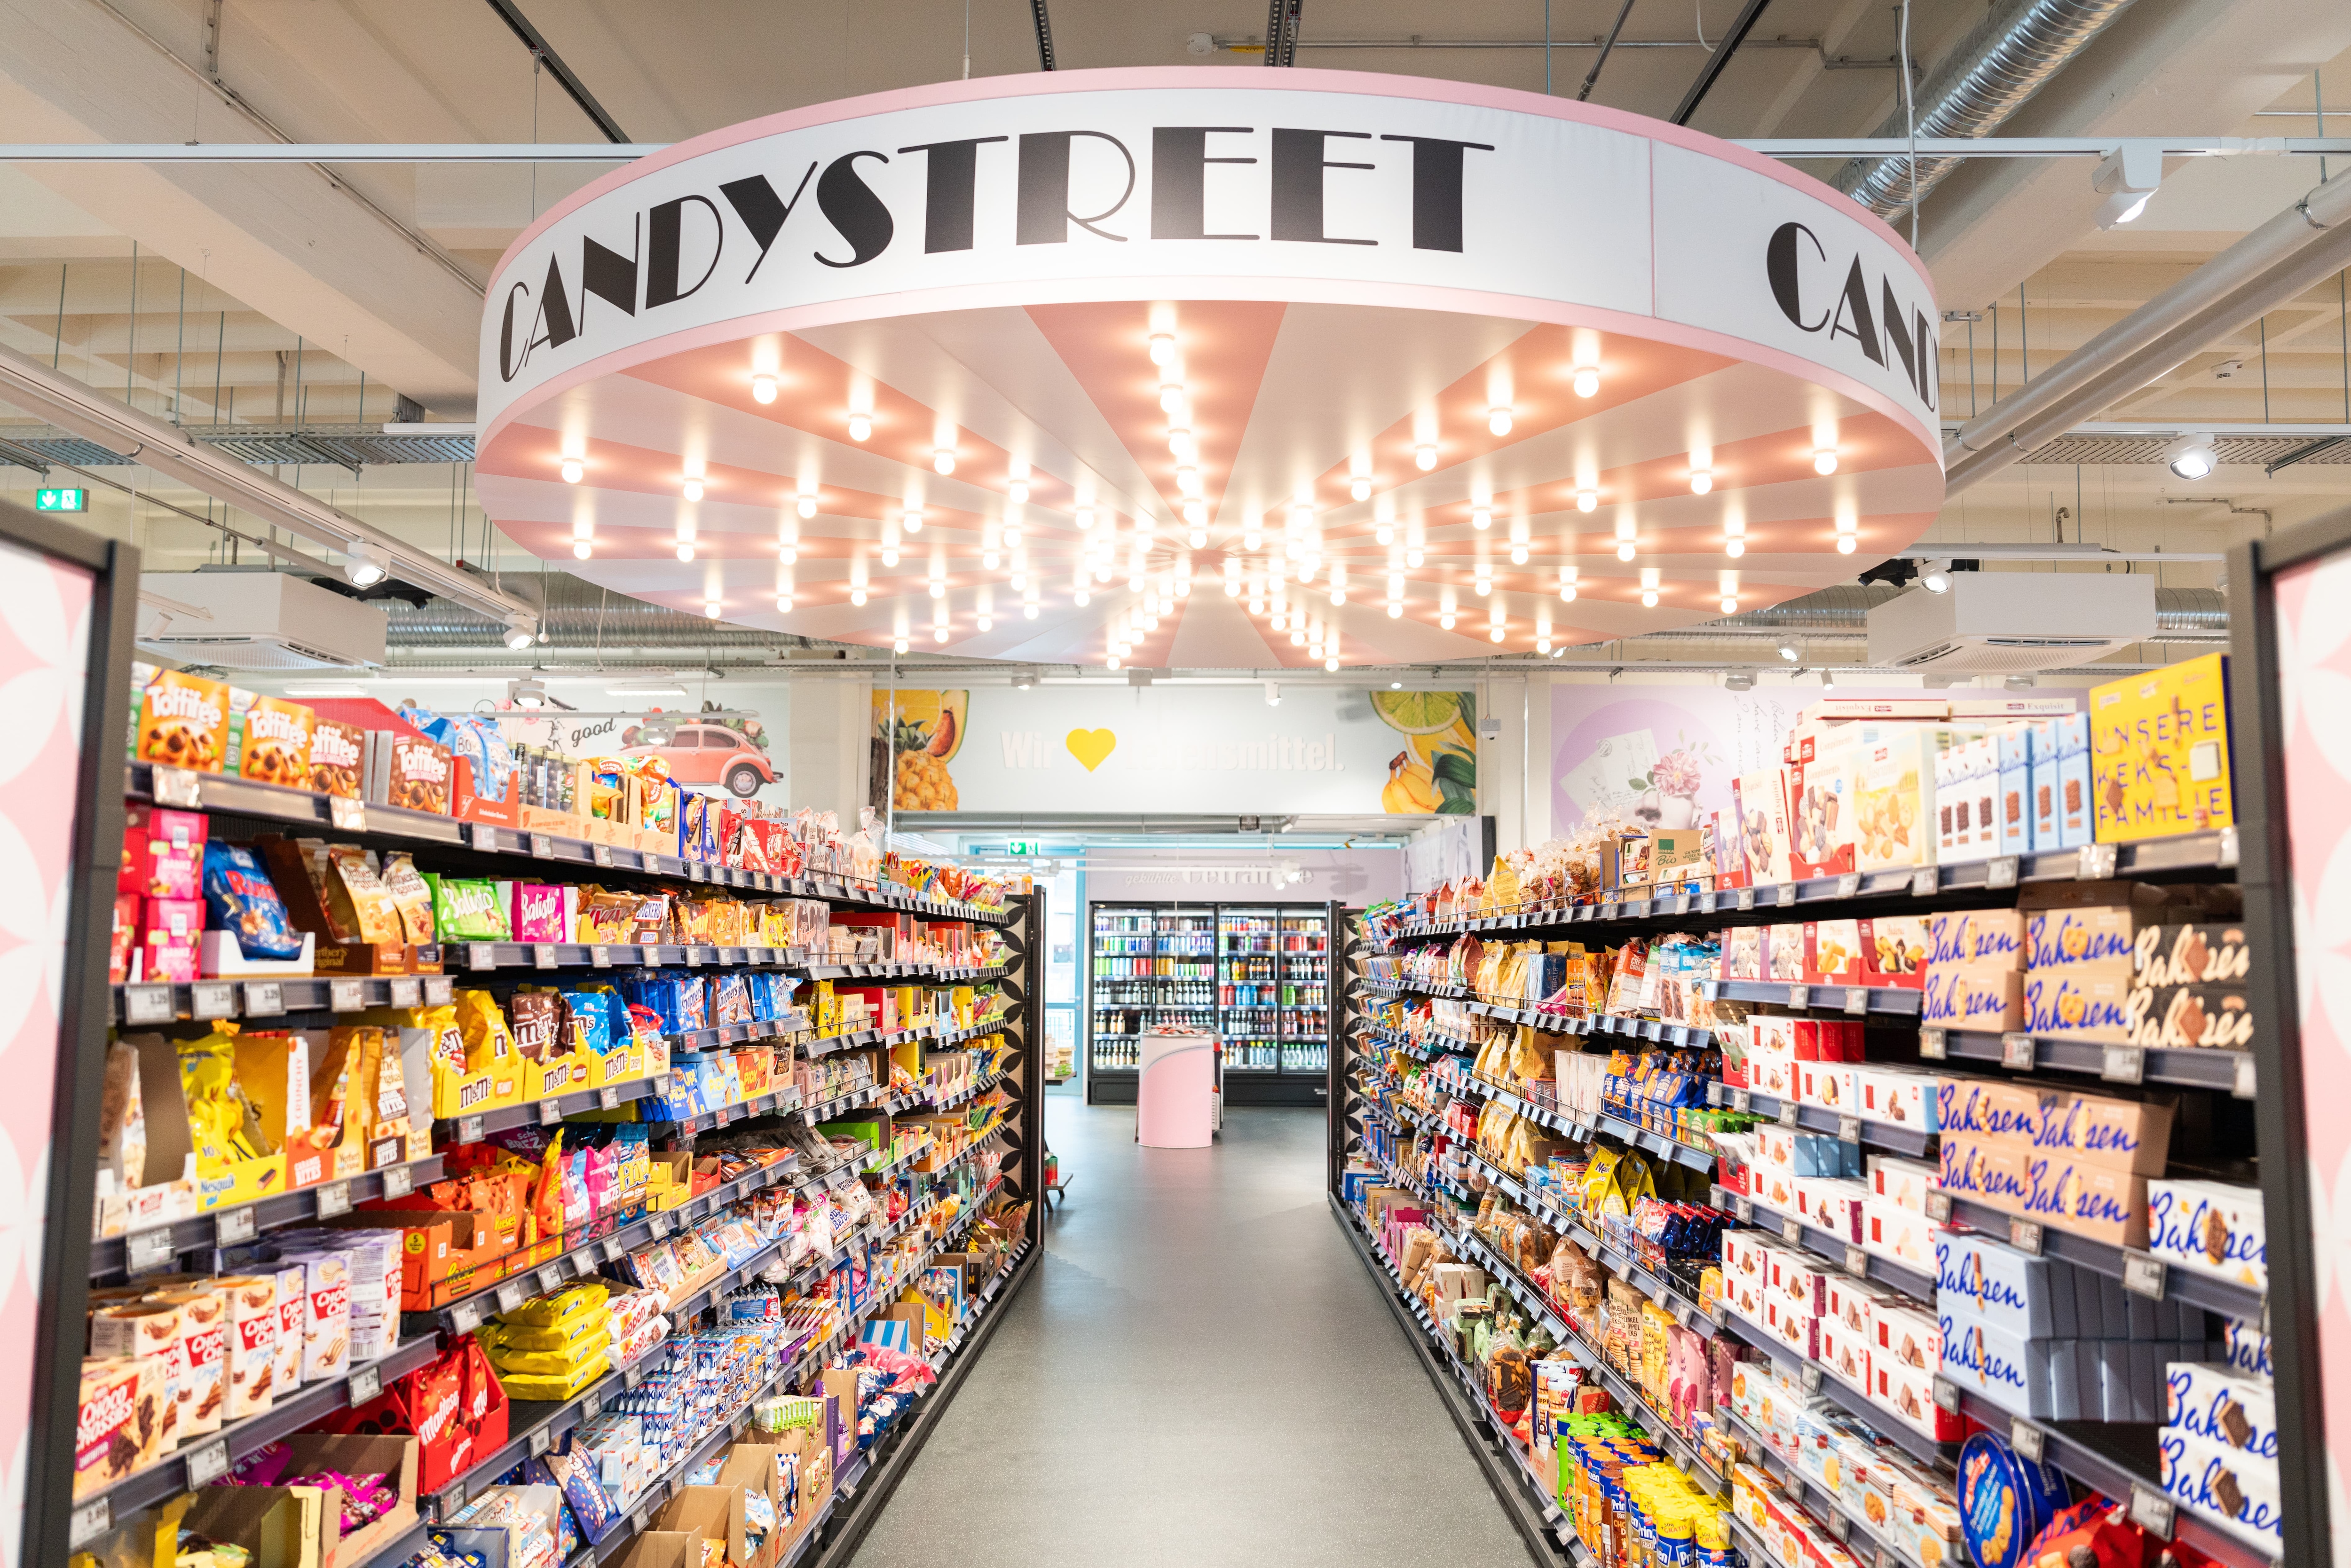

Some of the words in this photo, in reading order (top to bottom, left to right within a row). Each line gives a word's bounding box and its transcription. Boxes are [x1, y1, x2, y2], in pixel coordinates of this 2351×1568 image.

[500, 126, 1495, 382] CANDYSTREET
[1767, 222, 1939, 412] CAND
[146, 685, 222, 730] Toffifee
[2027, 701, 2064, 710] Exquisit
[246, 709, 308, 749] Toffifee
[310, 725, 360, 766] offifee
[570, 718, 617, 748] good
[2094, 703, 2218, 754] UNSERE
[397, 744, 447, 782] Toffifee
[1001, 731, 1058, 769] Wir
[1656, 855, 1677, 866] Bio
[1125, 872, 1177, 893] gekühlte
[1182, 864, 1314, 886] Geträne
[442, 887, 494, 920] Balisto
[522, 891, 556, 927] Balisto
[315, 946, 349, 957] erther's
[1930, 915, 2022, 965] Bahsen
[2026, 914, 2134, 970] Bahsen
[718, 985, 737, 1011] Knoppers
[1923, 969, 2007, 1020] Bahsen
[2024, 979, 2127, 1033] Bahsen
[543, 1061, 570, 1095] m&m's
[605, 1050, 628, 1082] m&m's
[683, 1069, 698, 1087] UP!
[725, 1061, 737, 1078] UP!
[758, 1055, 768, 1072] UP!
[295, 1058, 303, 1119] CRUNCHY
[459, 1074, 493, 1111] m&m's
[496, 1080, 513, 1095] PEANUT
[1937, 1083, 2036, 1134] Bahsen
[2034, 1095, 2139, 1151] Bahsen
[376, 1138, 397, 1154] CARAMEL
[377, 1148, 397, 1168] BITES
[294, 1155, 321, 1173] CARAMEL
[295, 1166, 322, 1187] BITES
[1941, 1143, 2027, 1198] Bahsen
[200, 1174, 236, 1194] Nesquik
[2024, 1159, 2130, 1223] Bahsen
[413, 1233, 418, 1242] 5
[494, 1213, 517, 1231] Reese's
[502, 1235, 516, 1245] minis
[1936, 1244, 2025, 1310] Bahsen
[854, 1292, 865, 1307] HARIBO
[620, 1305, 646, 1340] nippon
[1939, 1315, 2025, 1388] Bahsen
[81, 1384, 128, 1428] CHOCO
[1611, 1500, 1626, 1512] Prin
[1639, 1525, 1653, 1539] Prin
[1664, 1524, 1687, 1534] GRATIS
